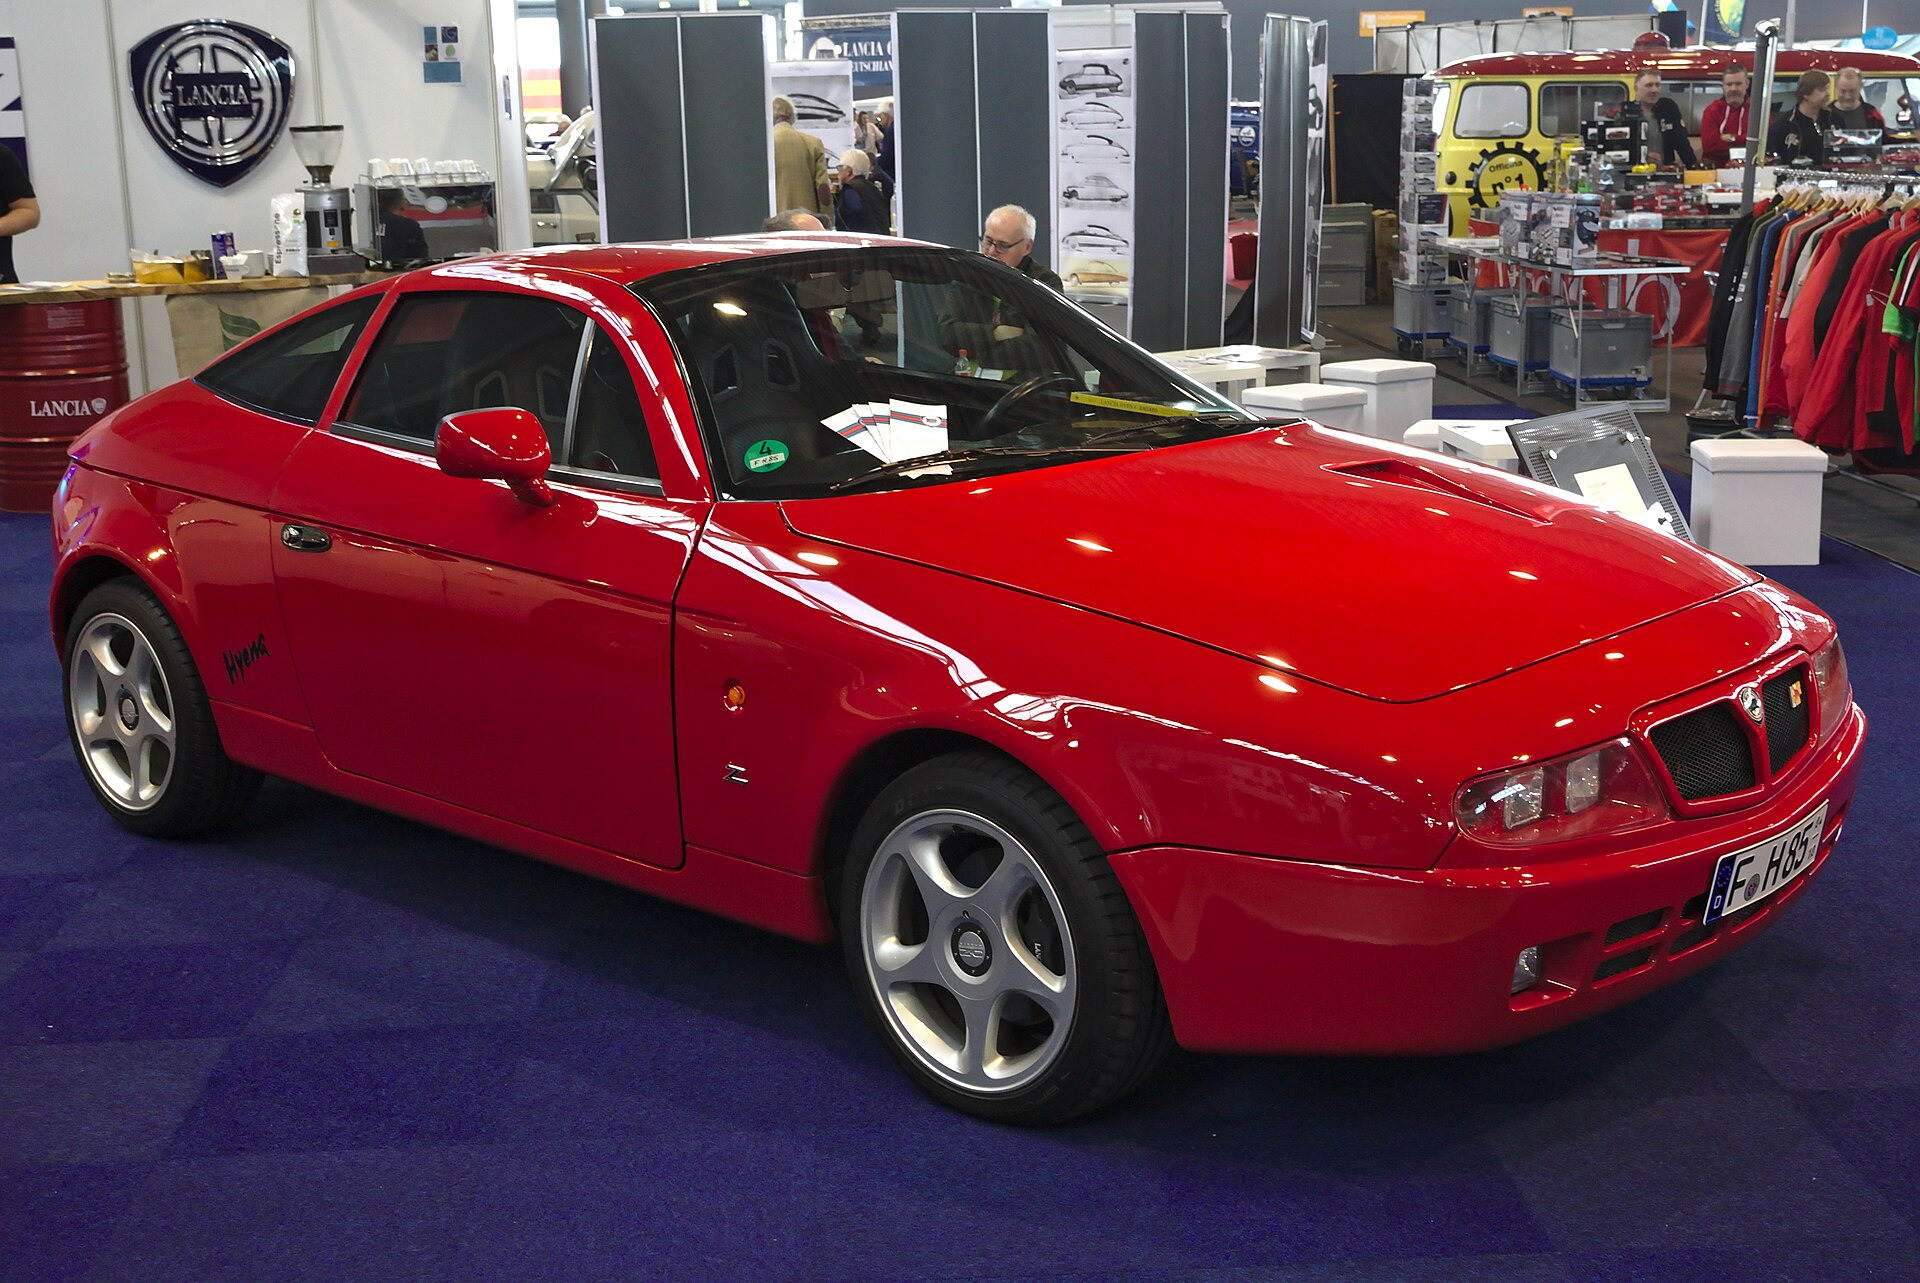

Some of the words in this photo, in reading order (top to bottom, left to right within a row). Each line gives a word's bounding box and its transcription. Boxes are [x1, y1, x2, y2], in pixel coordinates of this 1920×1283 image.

[843, 41, 883, 56] LANCIA
[176, 84, 249, 107] LANCIA
[1488, 160, 1523, 173] Officina
[30, 400, 91, 417] LANCIA
[759, 441, 772, 455] 4
[222, 632, 271, 688] Hyena
[1727, 855, 1755, 907] F
[1761, 821, 1814, 892] H85
[1713, 895, 1722, 910] D
